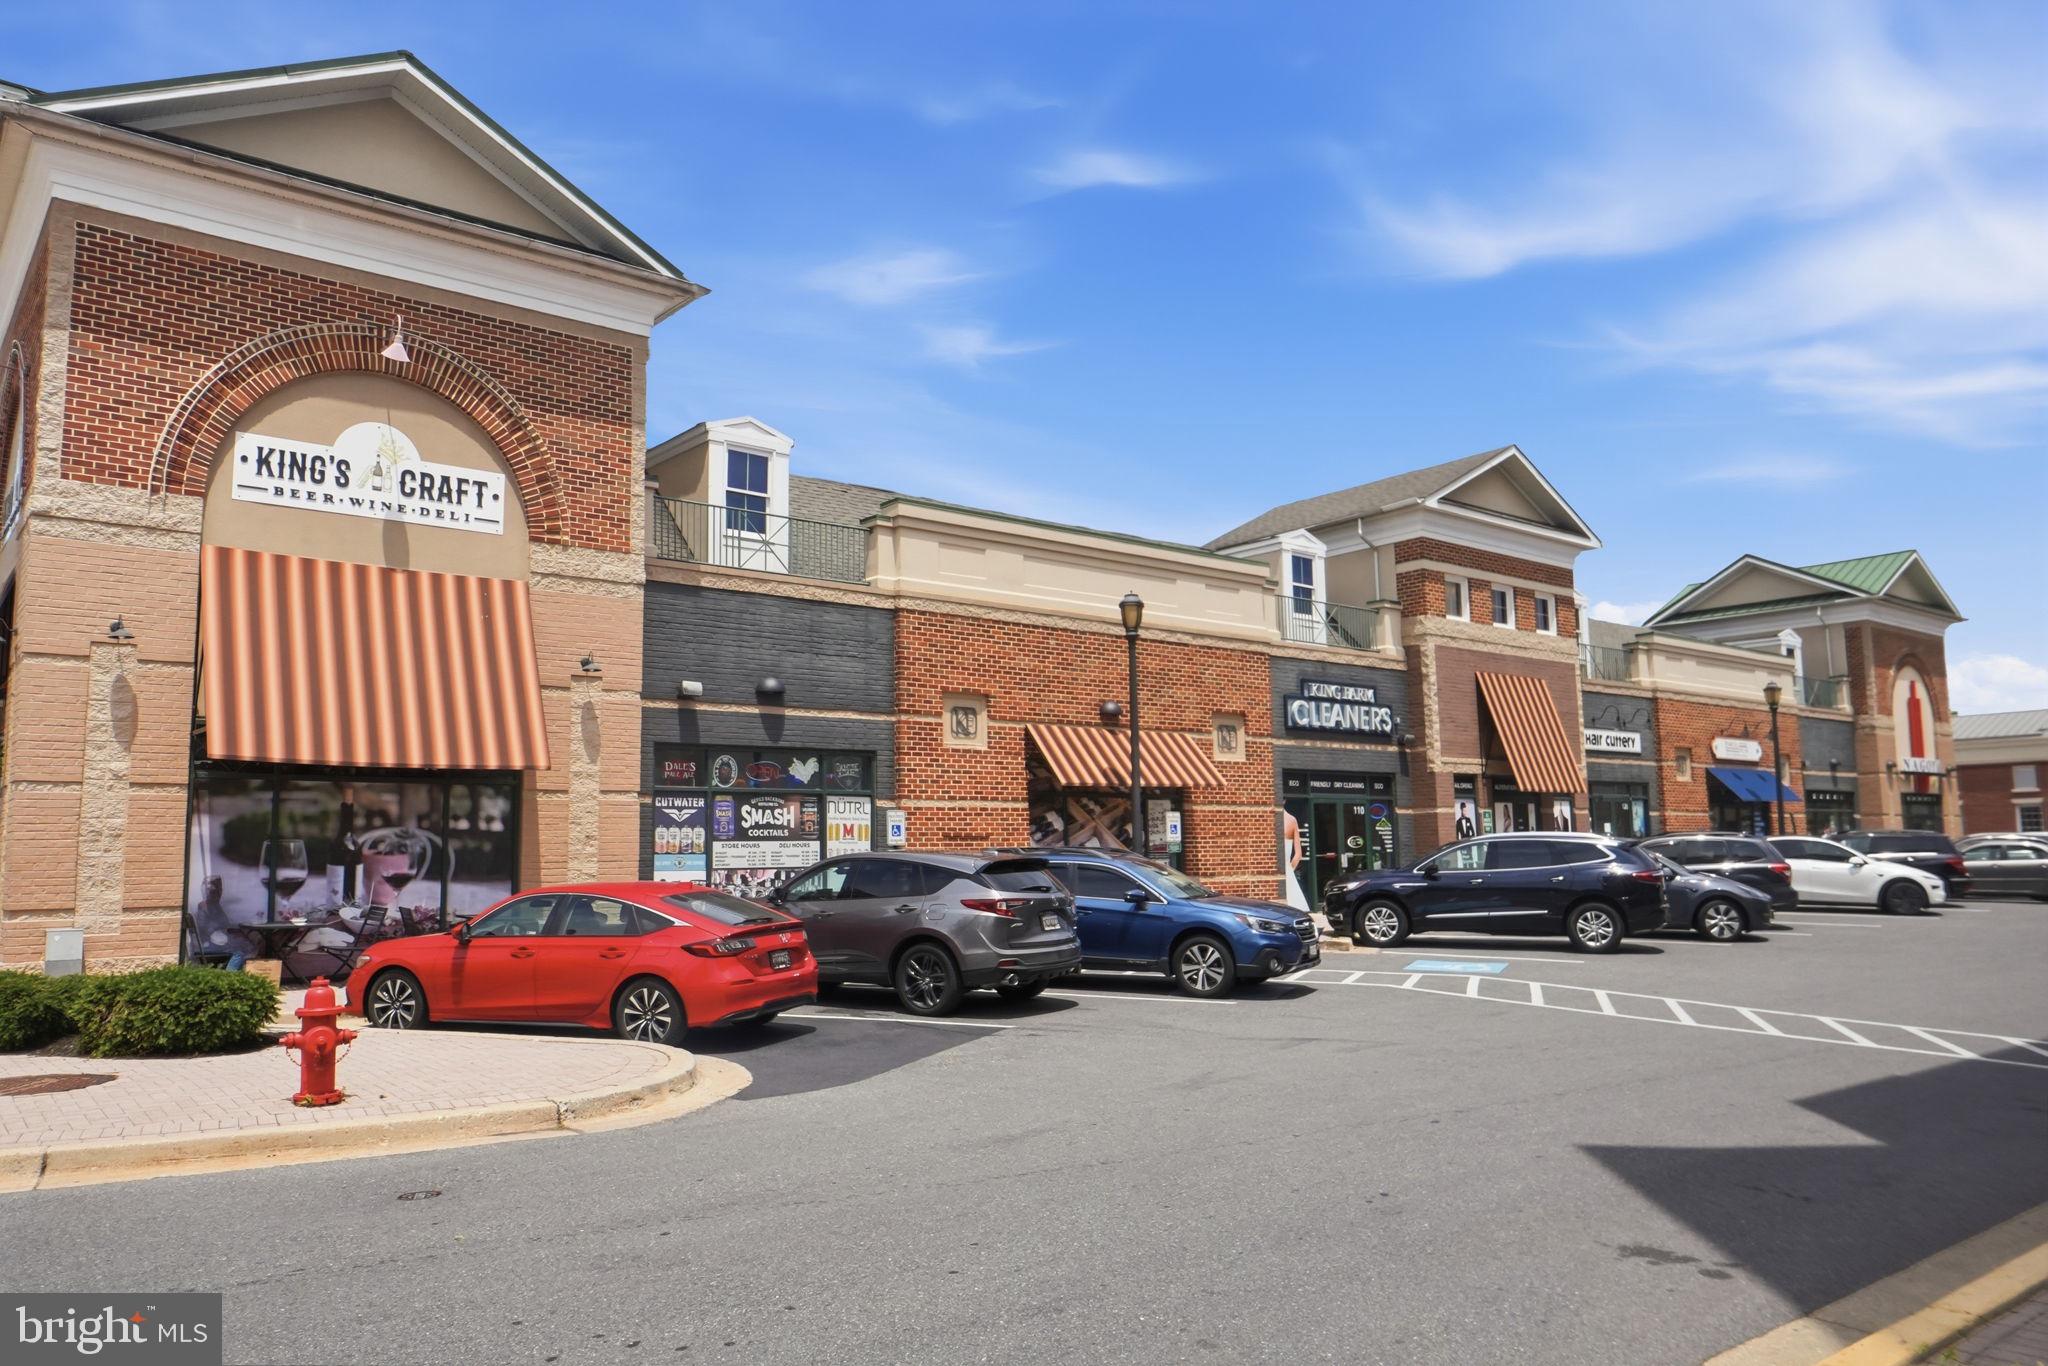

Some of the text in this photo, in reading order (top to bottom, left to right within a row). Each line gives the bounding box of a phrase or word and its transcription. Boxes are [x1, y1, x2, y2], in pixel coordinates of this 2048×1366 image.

[255, 446, 489, 508] KING'S CRAFT
[273, 485, 471, 522] BEER WINE DELI
[1309, 683, 1375, 703] KING FARM
[1291, 699, 1392, 733] CLEANERS
[655, 797, 705, 807] CUTWATER
[1353, 806, 1365, 815] 110
[741, 804, 795, 829] SMASH
[748, 829, 789, 837] COCKTAILS
